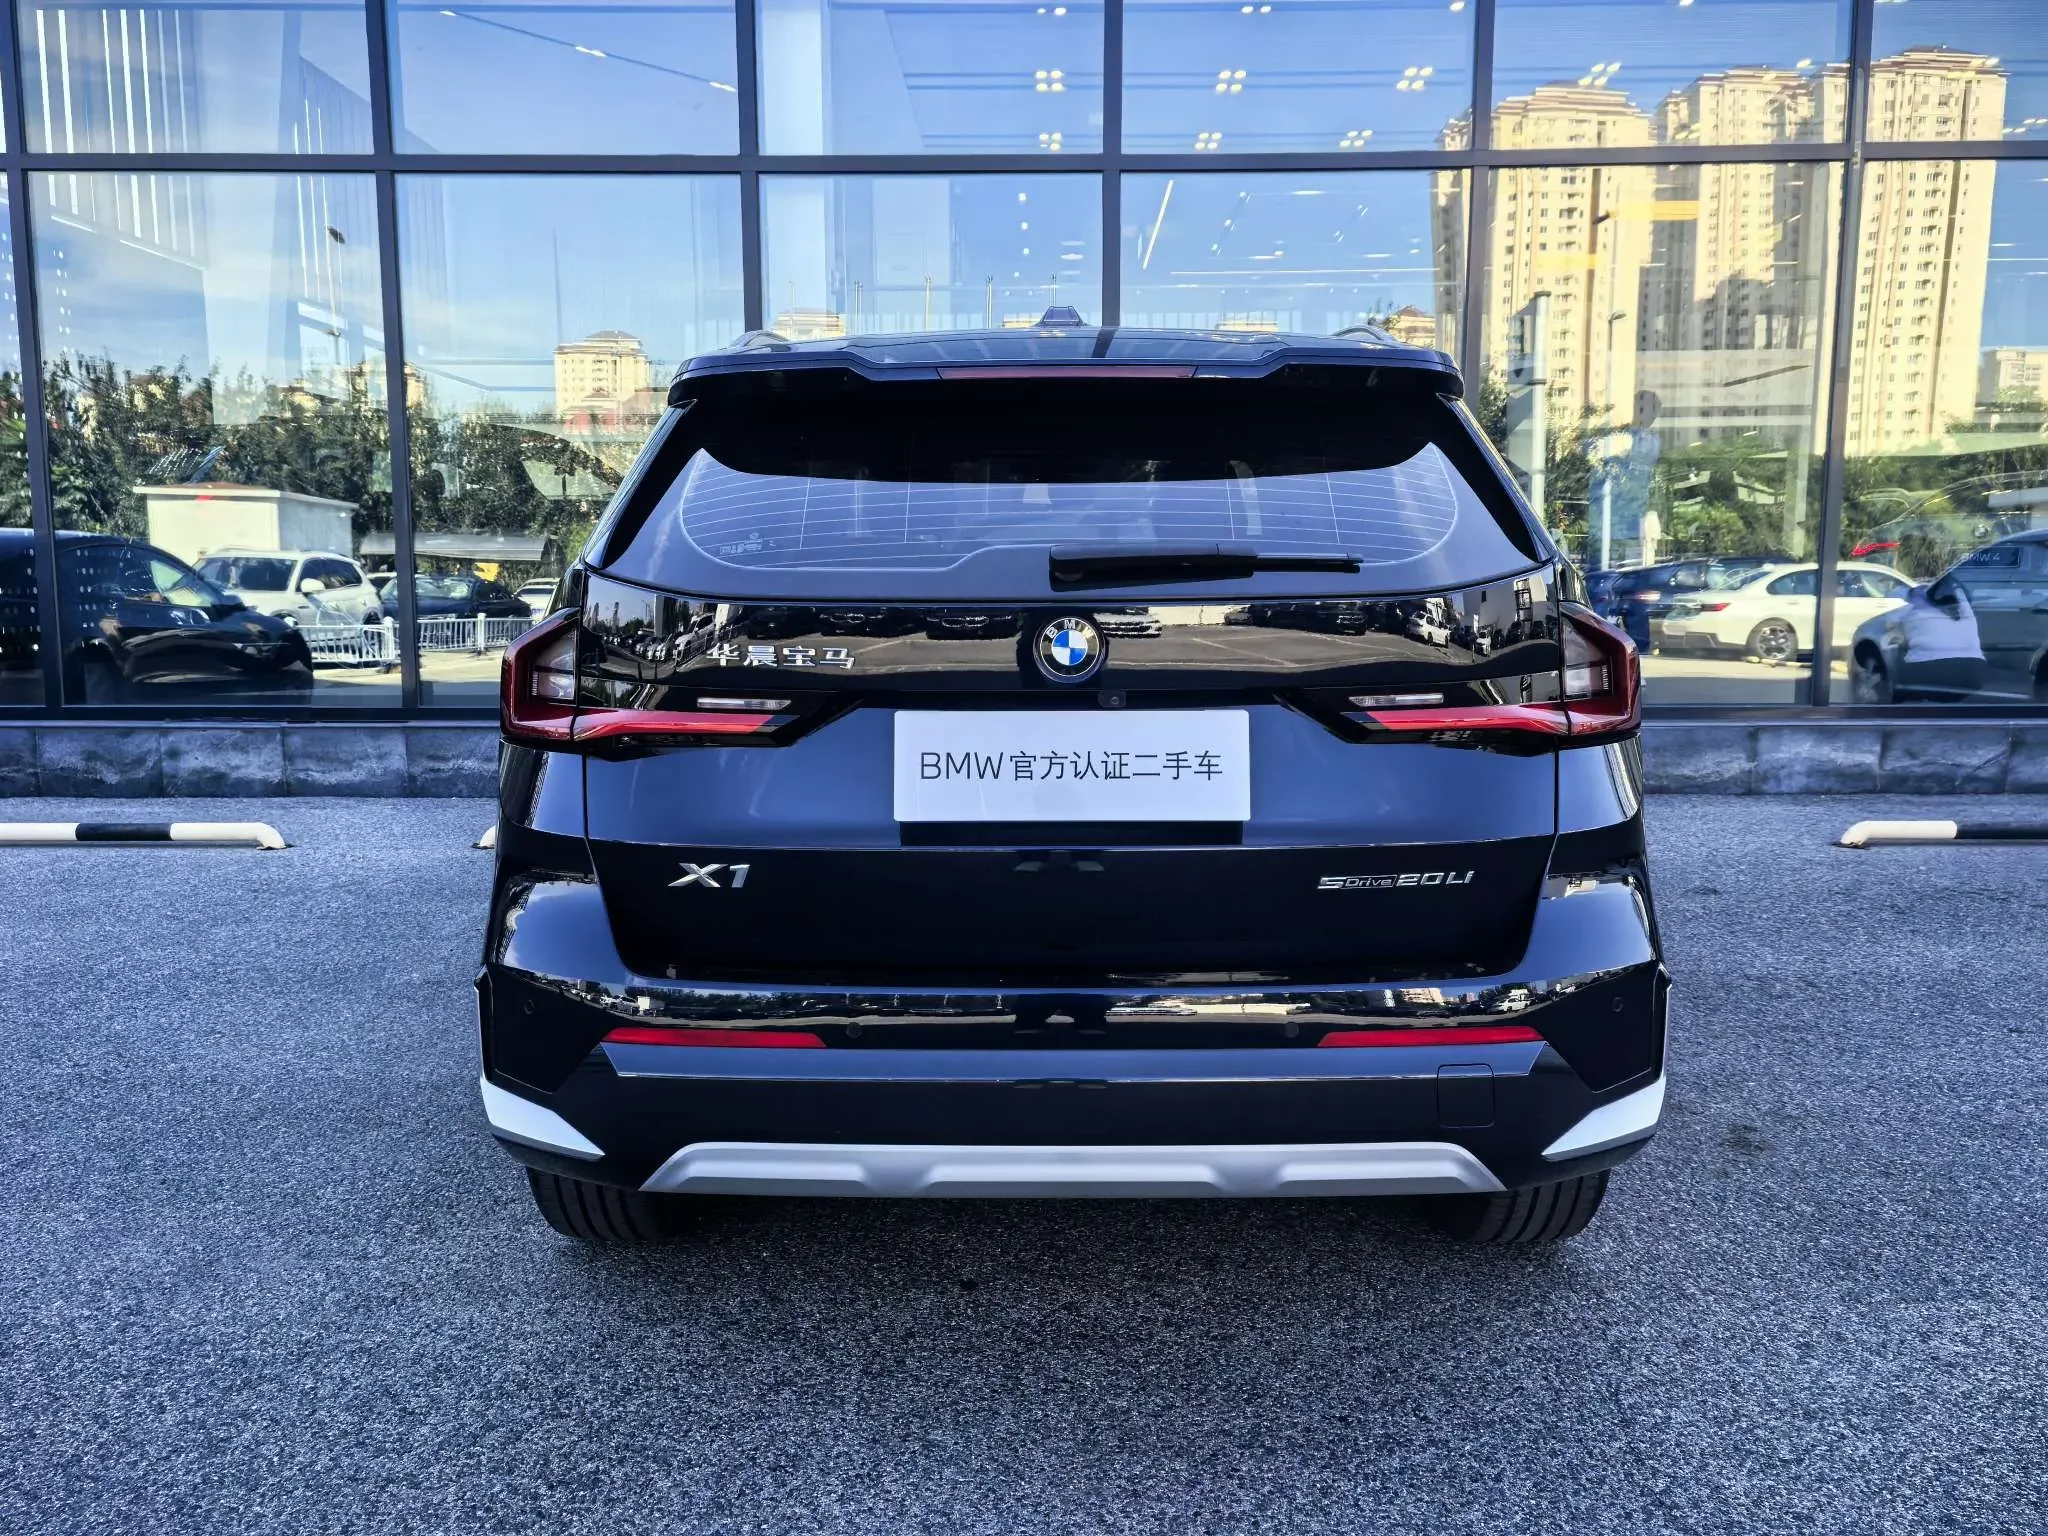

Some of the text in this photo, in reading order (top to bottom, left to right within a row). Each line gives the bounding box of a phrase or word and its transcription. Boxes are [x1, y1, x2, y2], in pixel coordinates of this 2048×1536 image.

[1045, 619, 1094, 639] BMW
[706, 642, 855, 669] 华晨宝马
[667, 862, 751, 888] X1
